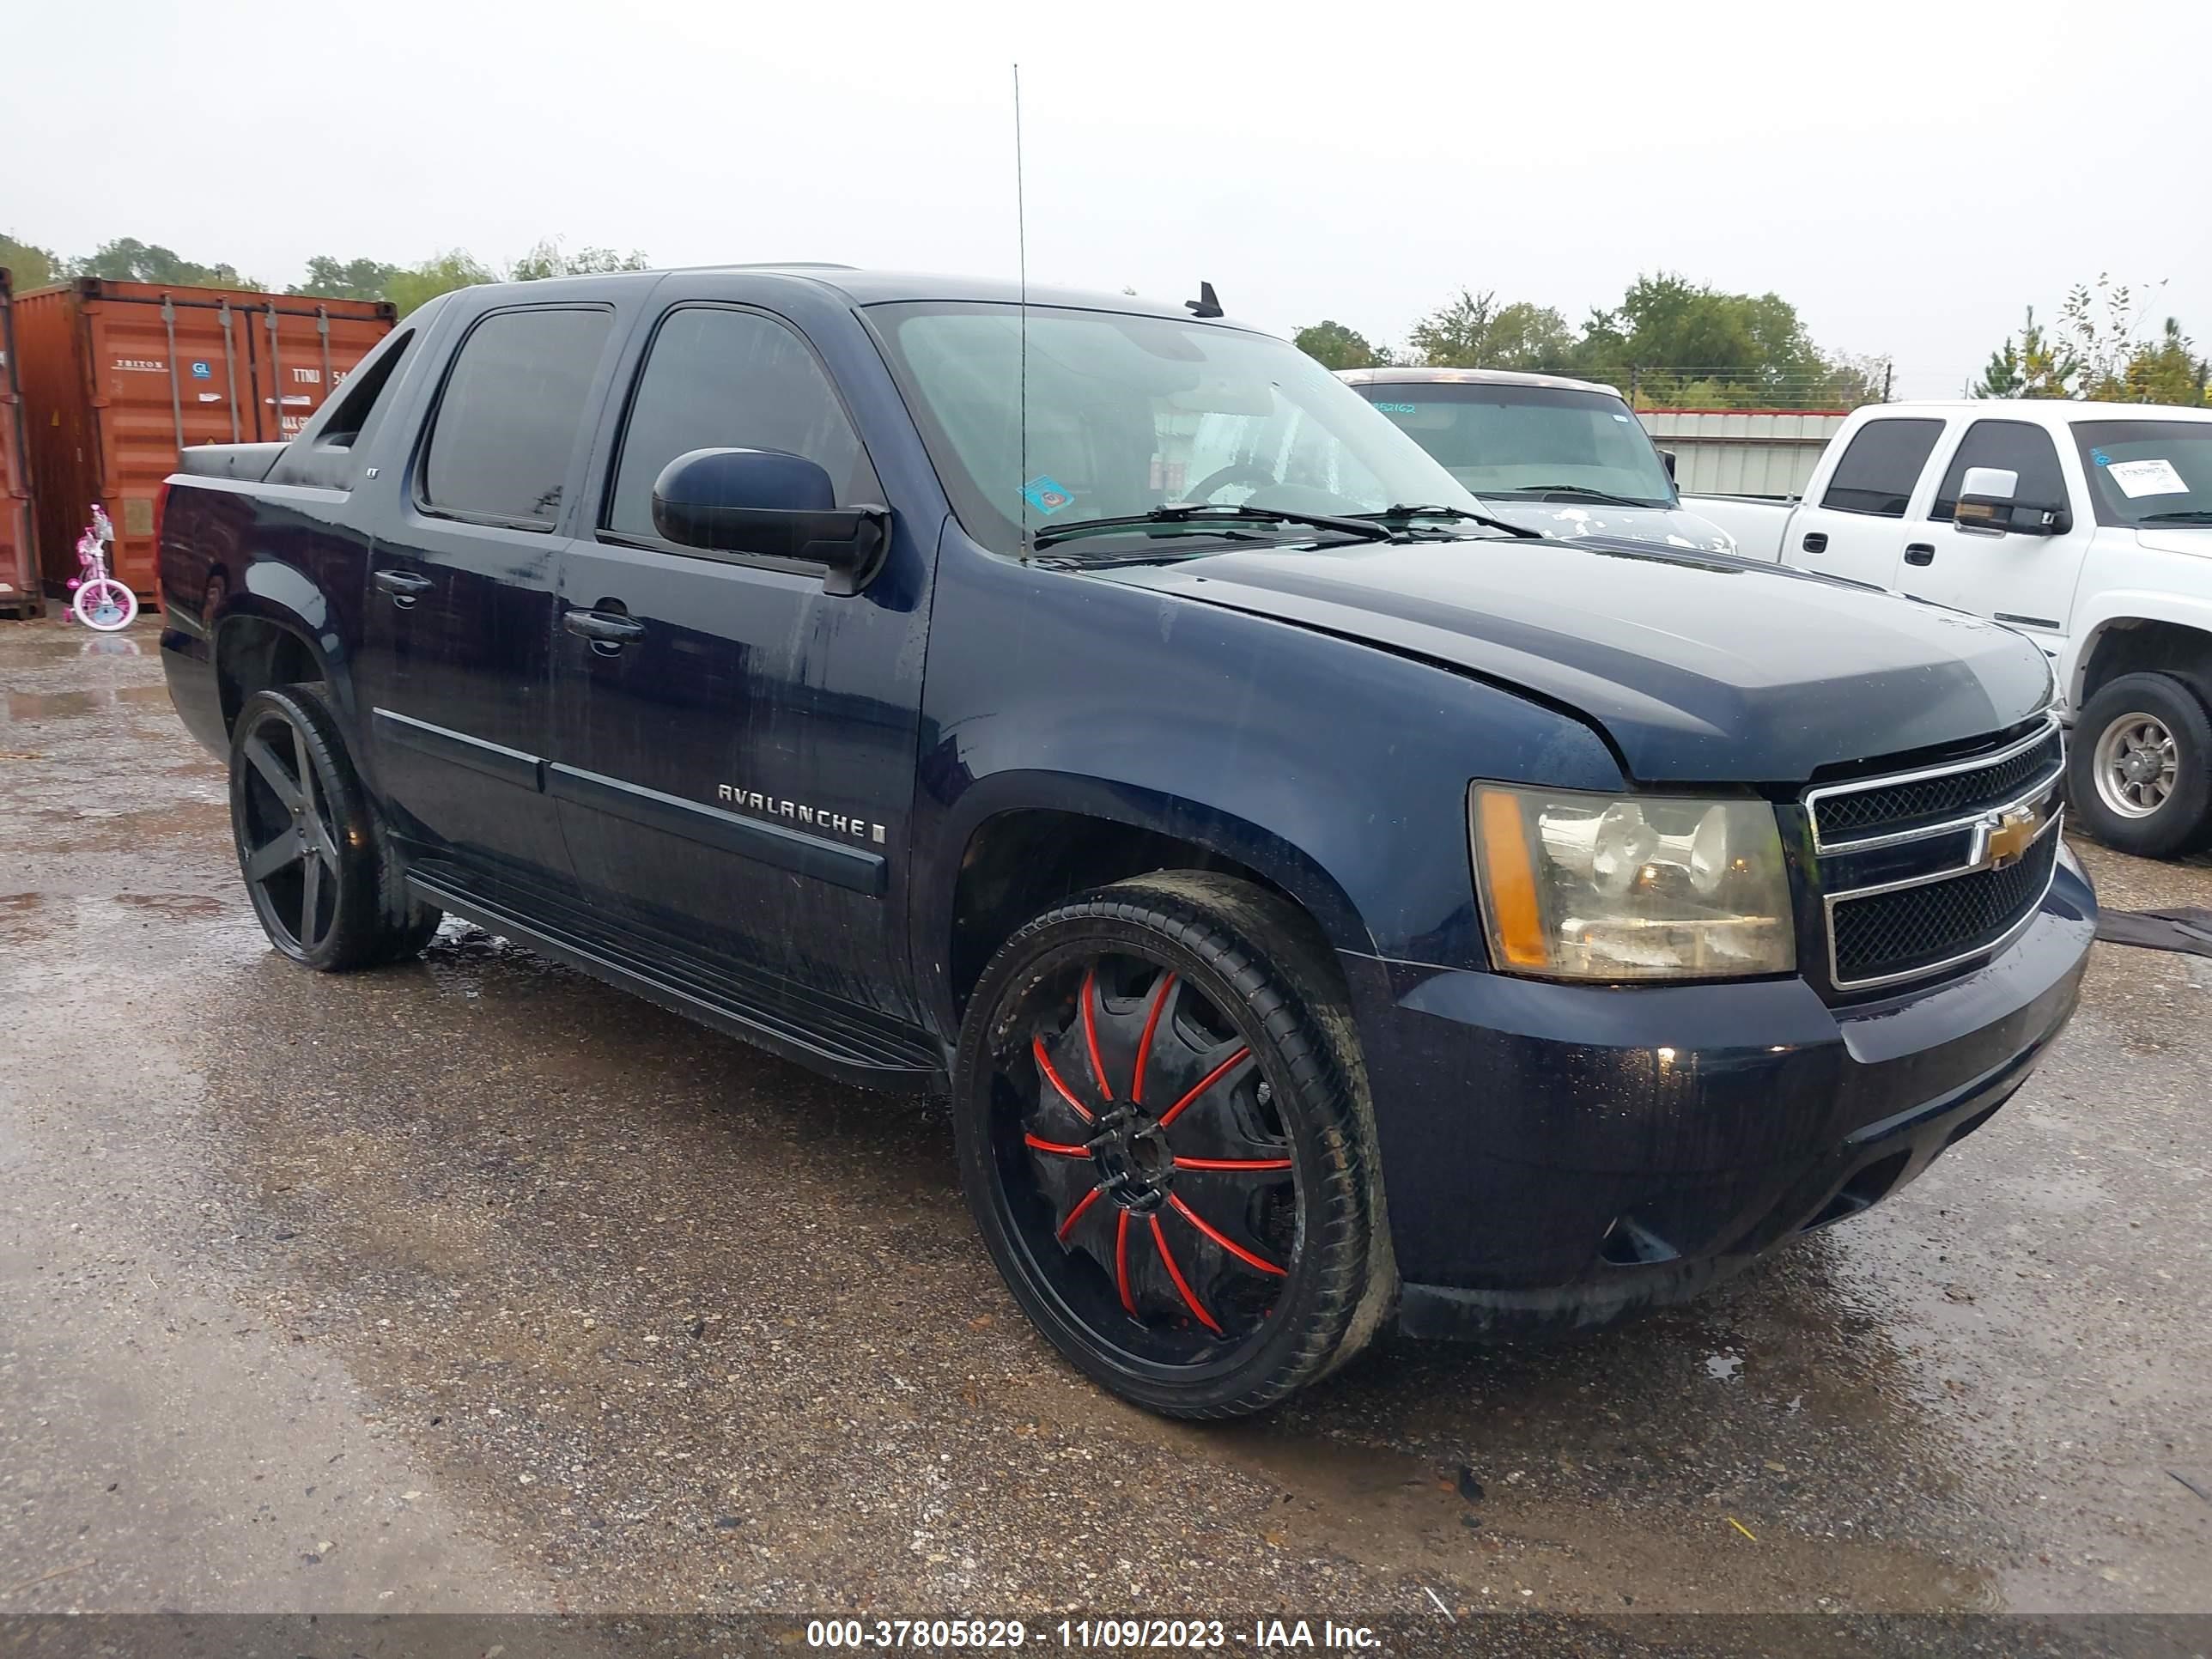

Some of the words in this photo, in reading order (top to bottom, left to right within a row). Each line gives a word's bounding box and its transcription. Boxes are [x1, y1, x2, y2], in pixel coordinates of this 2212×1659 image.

[116, 359, 163, 369] TRITON
[191, 362, 210, 373] GL
[718, 783, 865, 836] AVALANCHE
